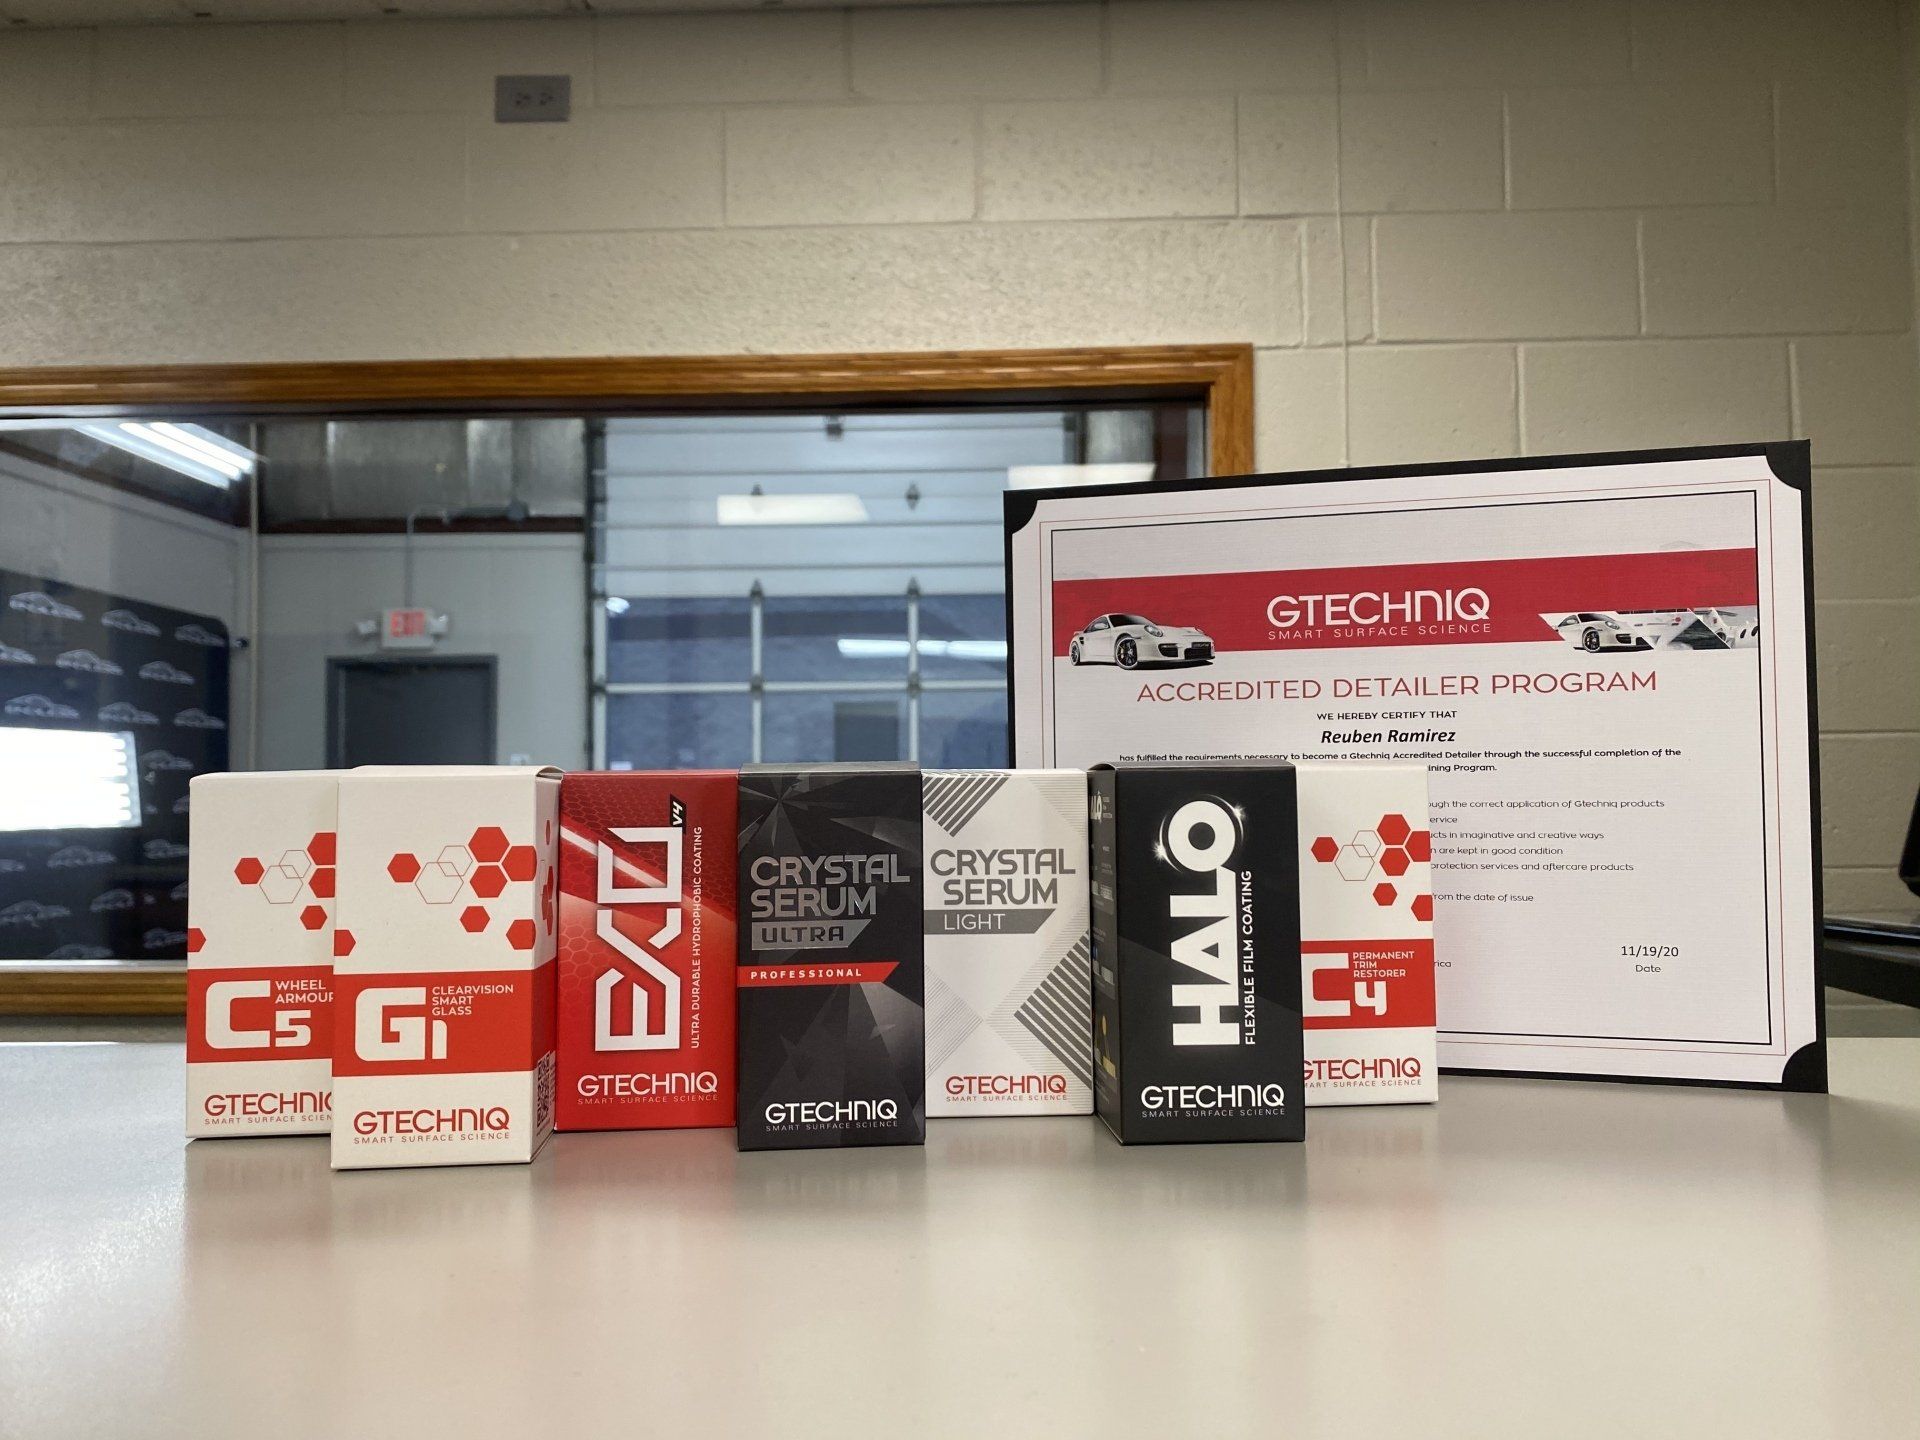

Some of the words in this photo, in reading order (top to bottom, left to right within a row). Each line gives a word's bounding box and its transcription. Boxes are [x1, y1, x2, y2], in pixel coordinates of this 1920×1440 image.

[1266, 587, 1491, 628] GTECHNIQ
[1268, 629, 1323, 640] SMART
[1333, 626, 1409, 639] SURFACE
[1418, 623, 1492, 635] SCIENCE
[1136, 680, 1322, 702] ACCREDITED
[1333, 675, 1480, 698] DETAILER
[1491, 671, 1657, 694] PROGRAM
[1316, 713, 1334, 721] WE
[1337, 712, 1379, 720] HEREBY
[1381, 711, 1426, 720] CERTIFY
[1429, 710, 1458, 719] THAT
[1320, 729, 1382, 743] Reuben
[1387, 729, 1456, 742] Ramirez
[1136, 754, 1167, 762] fulfilled
[1290, 752, 1300, 760] to
[1302, 752, 1339, 760] become
[1349, 752, 1390, 761] Gtechniq
[1393, 751, 1443, 759] Accredited
[1445, 750, 1482, 759] Detailer
[1484, 750, 1522, 760] through
[1524, 750, 1540, 758] the
[1542, 749, 1592, 759] successful
[1594, 748, 1649, 759] completion
[1652, 748, 1663, 759] of
[1664, 748, 1681, 757] the
[1453, 763, 1497, 772] Program.
[1452, 800, 1468, 808] the
[1506, 800, 1559, 809] application
[1561, 800, 1572, 809] of
[1574, 800, 1618, 809] Gtechniq
[1620, 800, 1665, 809] products
[1449, 831, 1458, 839] in
[1460, 831, 1515, 841] imaginative
[1516, 831, 1536, 839] and
[1537, 831, 1577, 839] creative
[1579, 832, 1605, 841] ways
[693, 827, 703, 875] COATING
[1457, 847, 1478, 857] kept
[1480, 847, 1489, 855] in
[1491, 847, 1517, 857] good
[1518, 847, 1563, 856] condition
[930, 848, 1076, 876] CRYSTAL
[1480, 862, 1519, 870] services
[1521, 862, 1540, 870] and
[1542, 862, 1588, 872] aftercare
[1589, 862, 1634, 872] products
[750, 853, 911, 887] CRYSTAL
[943, 878, 1058, 905] SERUM
[1456, 892, 1471, 901] the
[1473, 892, 1495, 902] date
[1497, 893, 1507, 903] of
[1510, 893, 1534, 902] issue
[750, 886, 877, 918] SERUM
[1241, 869, 1253, 935] COATING
[692, 877, 702, 957] HYDROPHOBIC
[944, 913, 1006, 930] LIGHT
[1167, 800, 1240, 1046] HALO
[761, 925, 844, 943] ULTRA
[1243, 939, 1254, 973] FILM
[1353, 951, 1415, 960] PERMANENT
[1620, 945, 1679, 958] 11/19/20
[1353, 961, 1377, 969] TRIM
[1635, 964, 1661, 973] Date
[750, 968, 862, 979] PROFESSIONAL
[1353, 969, 1406, 978] RESTORER
[275, 979, 326, 991] WHEEL
[432, 984, 514, 995] CLEARVISION
[692, 961, 701, 1010] DURABLE
[432, 995, 474, 1006] SMART
[205, 980, 312, 1050] C5
[432, 1006, 473, 1016] GLASS
[1244, 976, 1256, 1045] FLEXIBLE
[691, 1013, 700, 1049] ULTRA
[577, 1071, 719, 1096] GTECHNIQ
[945, 1074, 1067, 1095] GTECHNIQ
[1381, 1079, 1422, 1087] SCIENCE
[620, 1096, 667, 1104] SURFACE
[673, 1094, 719, 1102] SCIENCE
[1140, 1083, 1285, 1109] GTECHNIQ
[765, 1099, 898, 1124] GTECHNIQ
[1141, 1110, 1180, 1118] SMART
[1185, 1109, 1234, 1117] SURFACE
[1240, 1108, 1285, 1116] SCIENCE
[204, 1117, 241, 1125] SMART
[247, 1115, 295, 1124] SURFACE
[353, 1106, 510, 1135] GTECHNIQ
[765, 1124, 800, 1132] SMART
[806, 1122, 851, 1130] SURFACE
[855, 1120, 898, 1129] SCIENCE
[353, 1136, 394, 1144] SMART
[401, 1134, 454, 1143] SURFACE
[460, 1132, 510, 1141] SCIENCE
